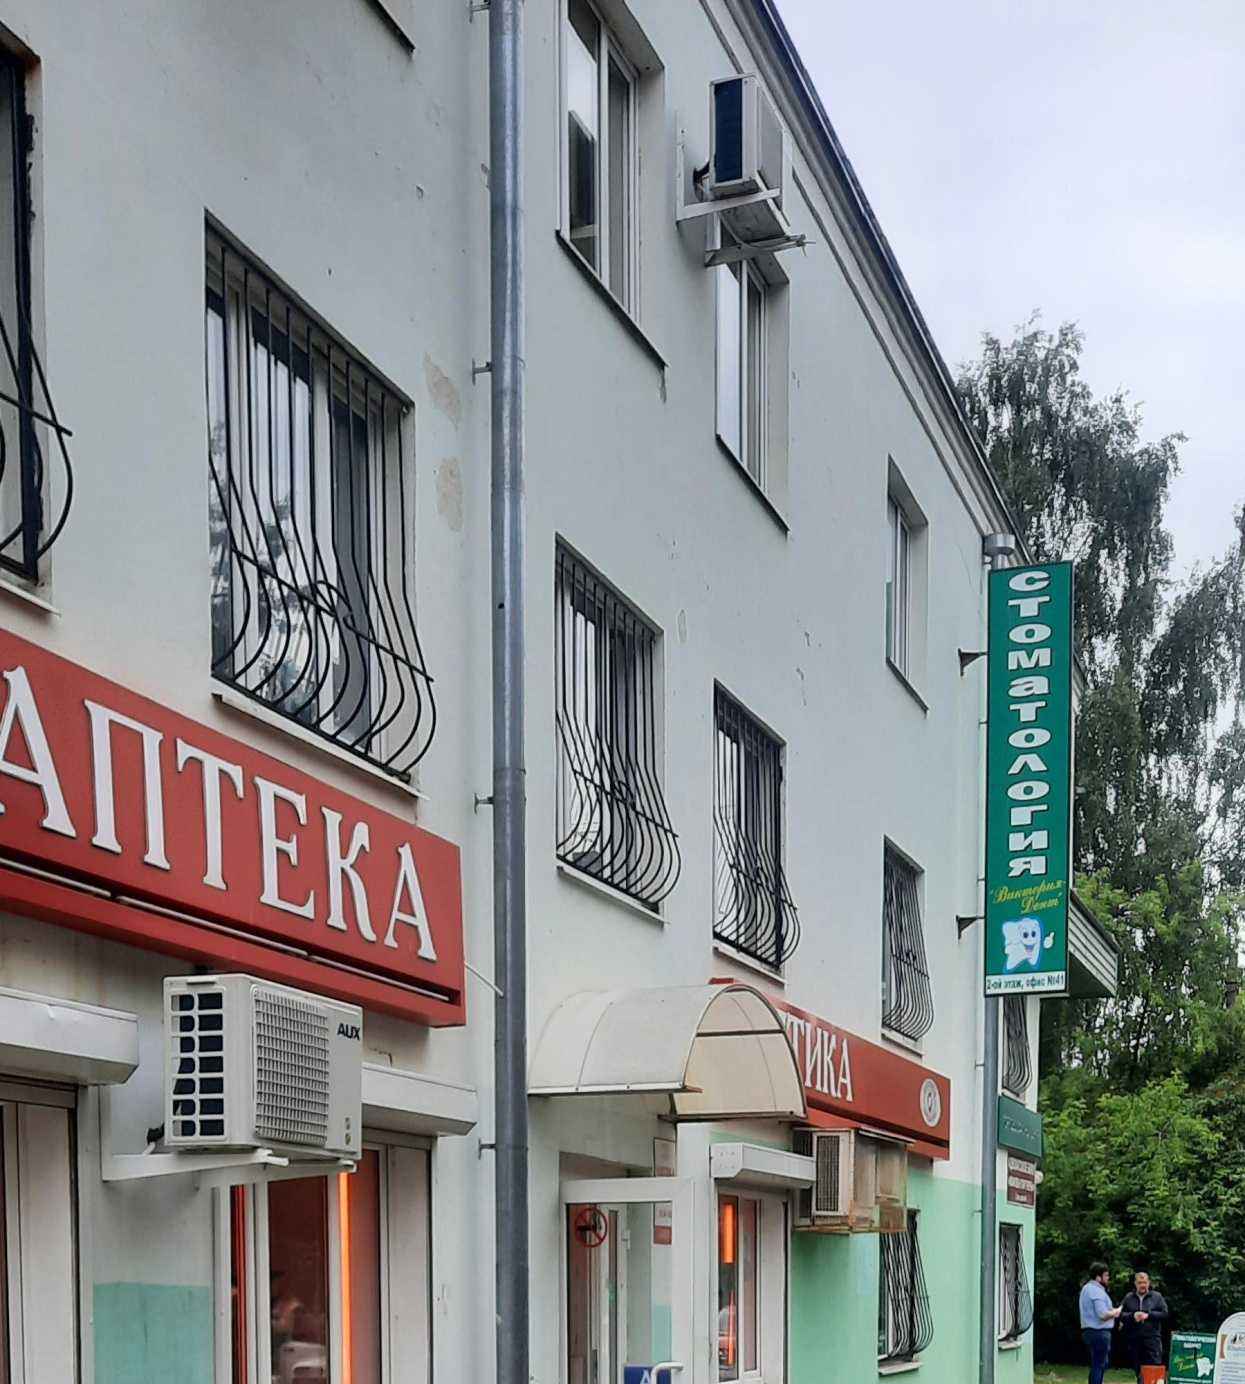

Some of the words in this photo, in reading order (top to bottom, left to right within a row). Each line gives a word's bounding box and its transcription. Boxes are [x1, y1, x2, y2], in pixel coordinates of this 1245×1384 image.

[0, 665, 438, 961] АПТЕКА
[336, 1023, 360, 1041] AUX
[777, 1010, 853, 1102] ТИКА
